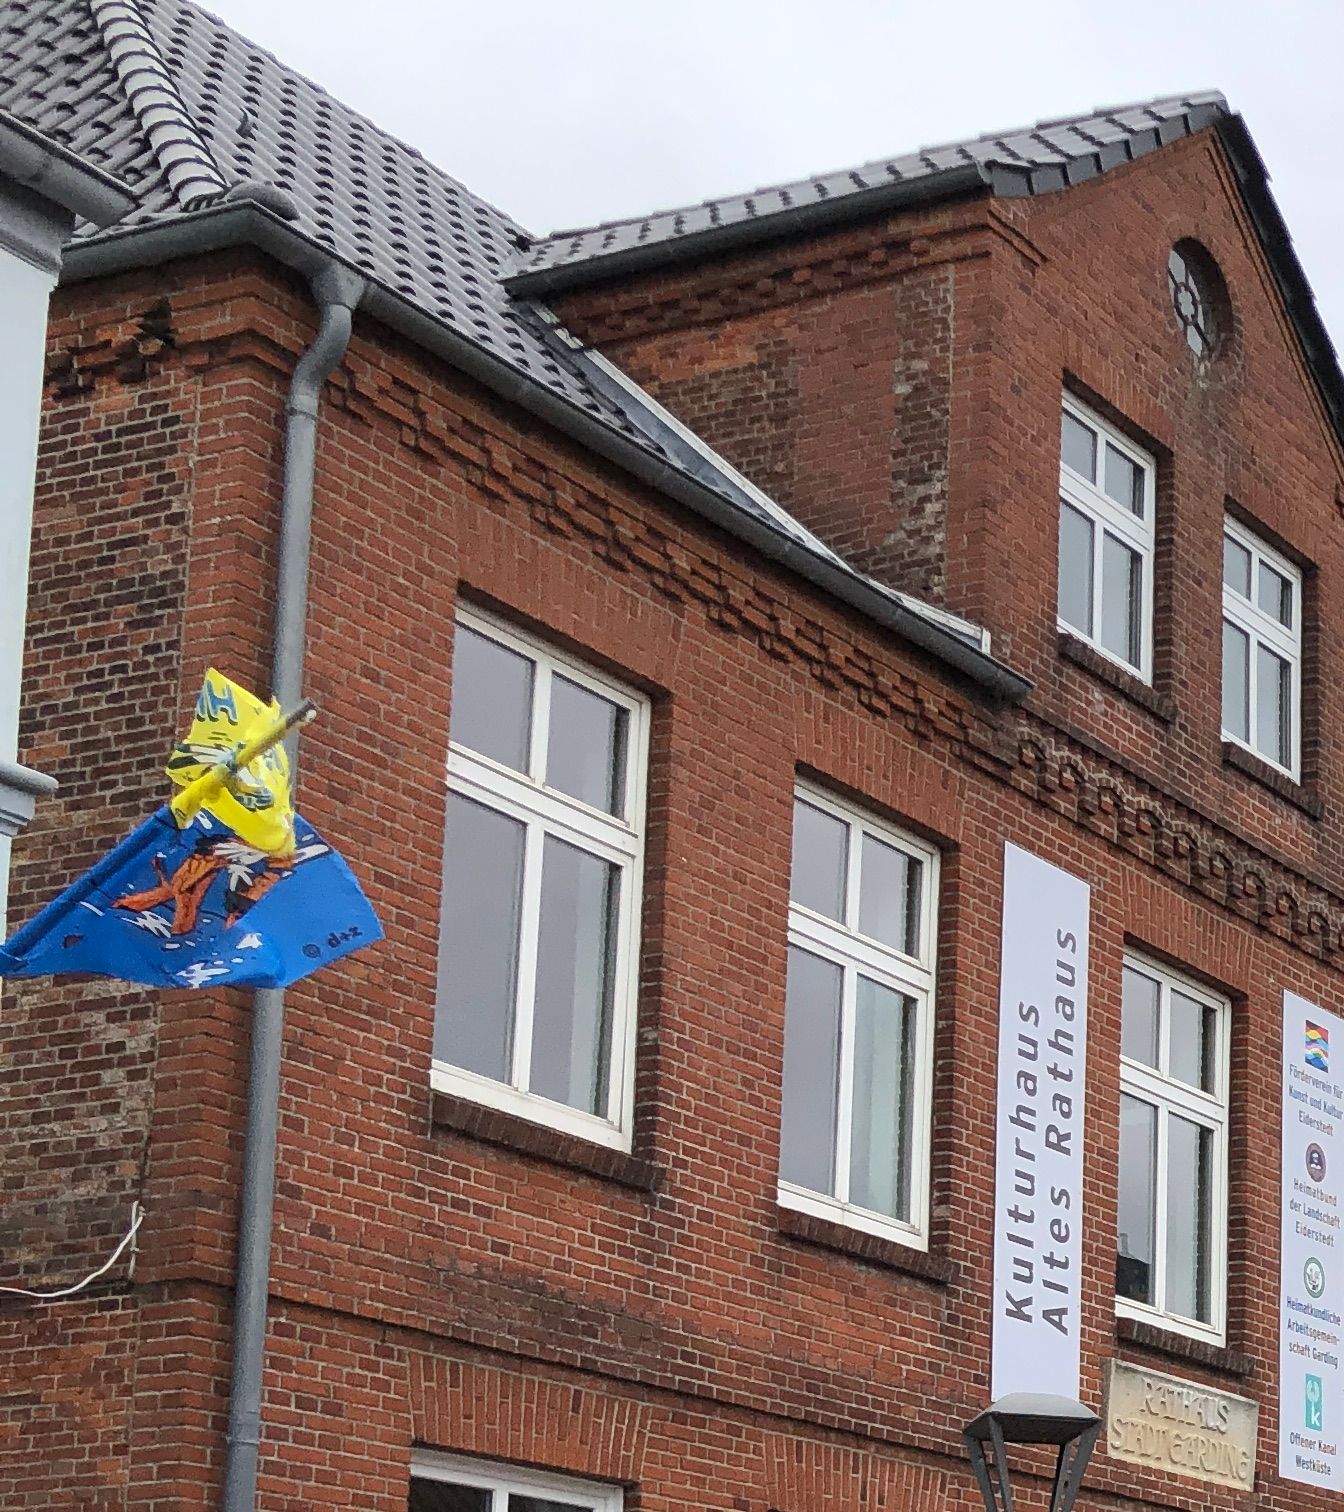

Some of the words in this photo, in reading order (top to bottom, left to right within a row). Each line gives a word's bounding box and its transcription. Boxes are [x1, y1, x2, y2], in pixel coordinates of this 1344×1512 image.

[1044, 928, 1079, 1156] Rathaus
[1289, 1063, 1333, 1095] Förderverein
[1333, 1084, 1344, 1099] für
[1288, 1084, 1309, 1104] Kunst
[1310, 1095, 1322, 1111] und
[1323, 1100, 1344, 1120] Kultur
[1298, 1109, 1334, 1137] Eiderstedt
[1005, 1000, 1041, 1324] Kulturhaus
[1293, 1177, 1337, 1207] Heimatbund
[1289, 1197, 1302, 1212] der
[1303, 1202, 1341, 1229] Landschaft
[1295, 1220, 1335, 1247] Eiderstedt
[1041, 1185, 1074, 1337] Altes
[1286, 1295, 1341, 1326] Heimatkundliche
[1287, 1318, 1340, 1345] Arbeitsgemein-
[1288, 1341, 1311, 1358] schaft
[1312, 1348, 1339, 1370] Garding
[1139, 1376, 1230, 1435] RATHAUS
[1169, 1431, 1251, 1480] GARDING
[1289, 1431, 1317, 1451] Offener
[1318, 1439, 1337, 1456] Kanal
[1295, 1454, 1332, 1476] Westküste
